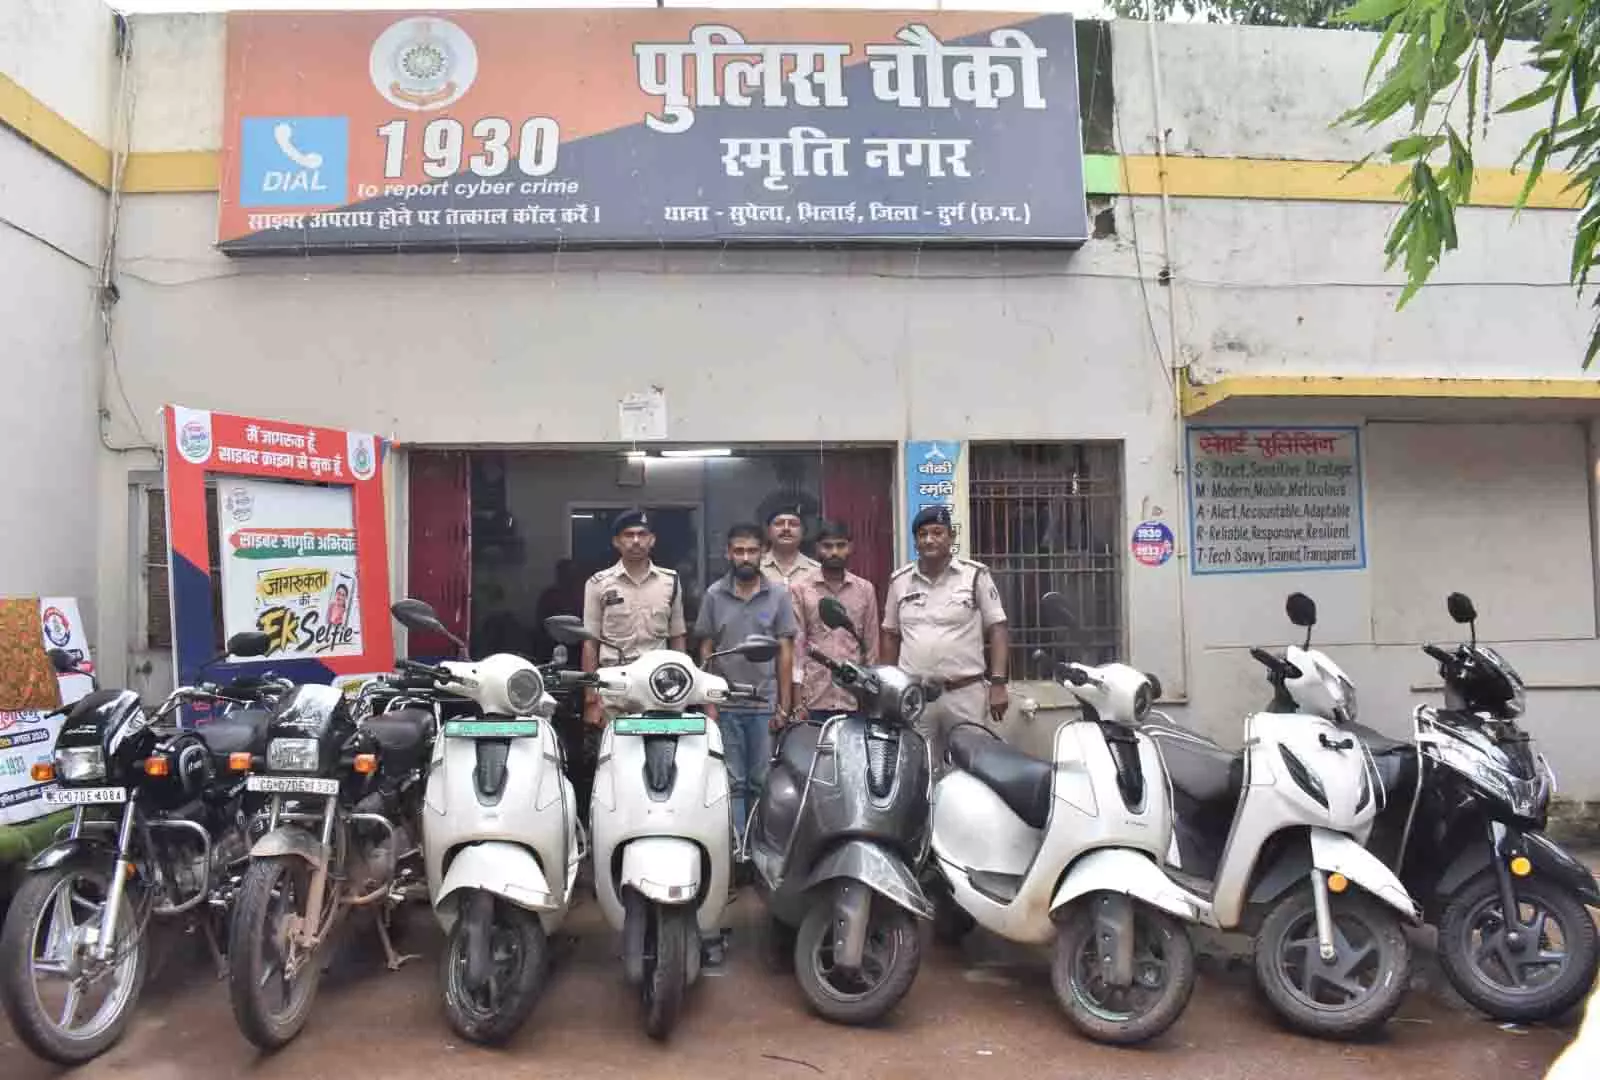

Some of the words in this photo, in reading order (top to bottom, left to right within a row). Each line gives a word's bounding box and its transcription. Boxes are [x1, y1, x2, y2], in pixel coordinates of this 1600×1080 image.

[632, 24, 852, 133] पुलिस
[864, 24, 1048, 110] चौकी
[376, 116, 561, 178] 1930
[719, 126, 850, 191] स्मृति
[863, 138, 973, 178] नगर
[262, 170, 329, 193] DIAL
[384, 180, 450, 200] report
[454, 179, 514, 199] cyber
[519, 178, 580, 194] crime
[418, 209, 441, 226] पर
[445, 207, 508, 225] तत्काल
[512, 203, 556, 225] कॉल
[869, 201, 919, 222] जिला
[295, 610, 353, 652] Selfie
